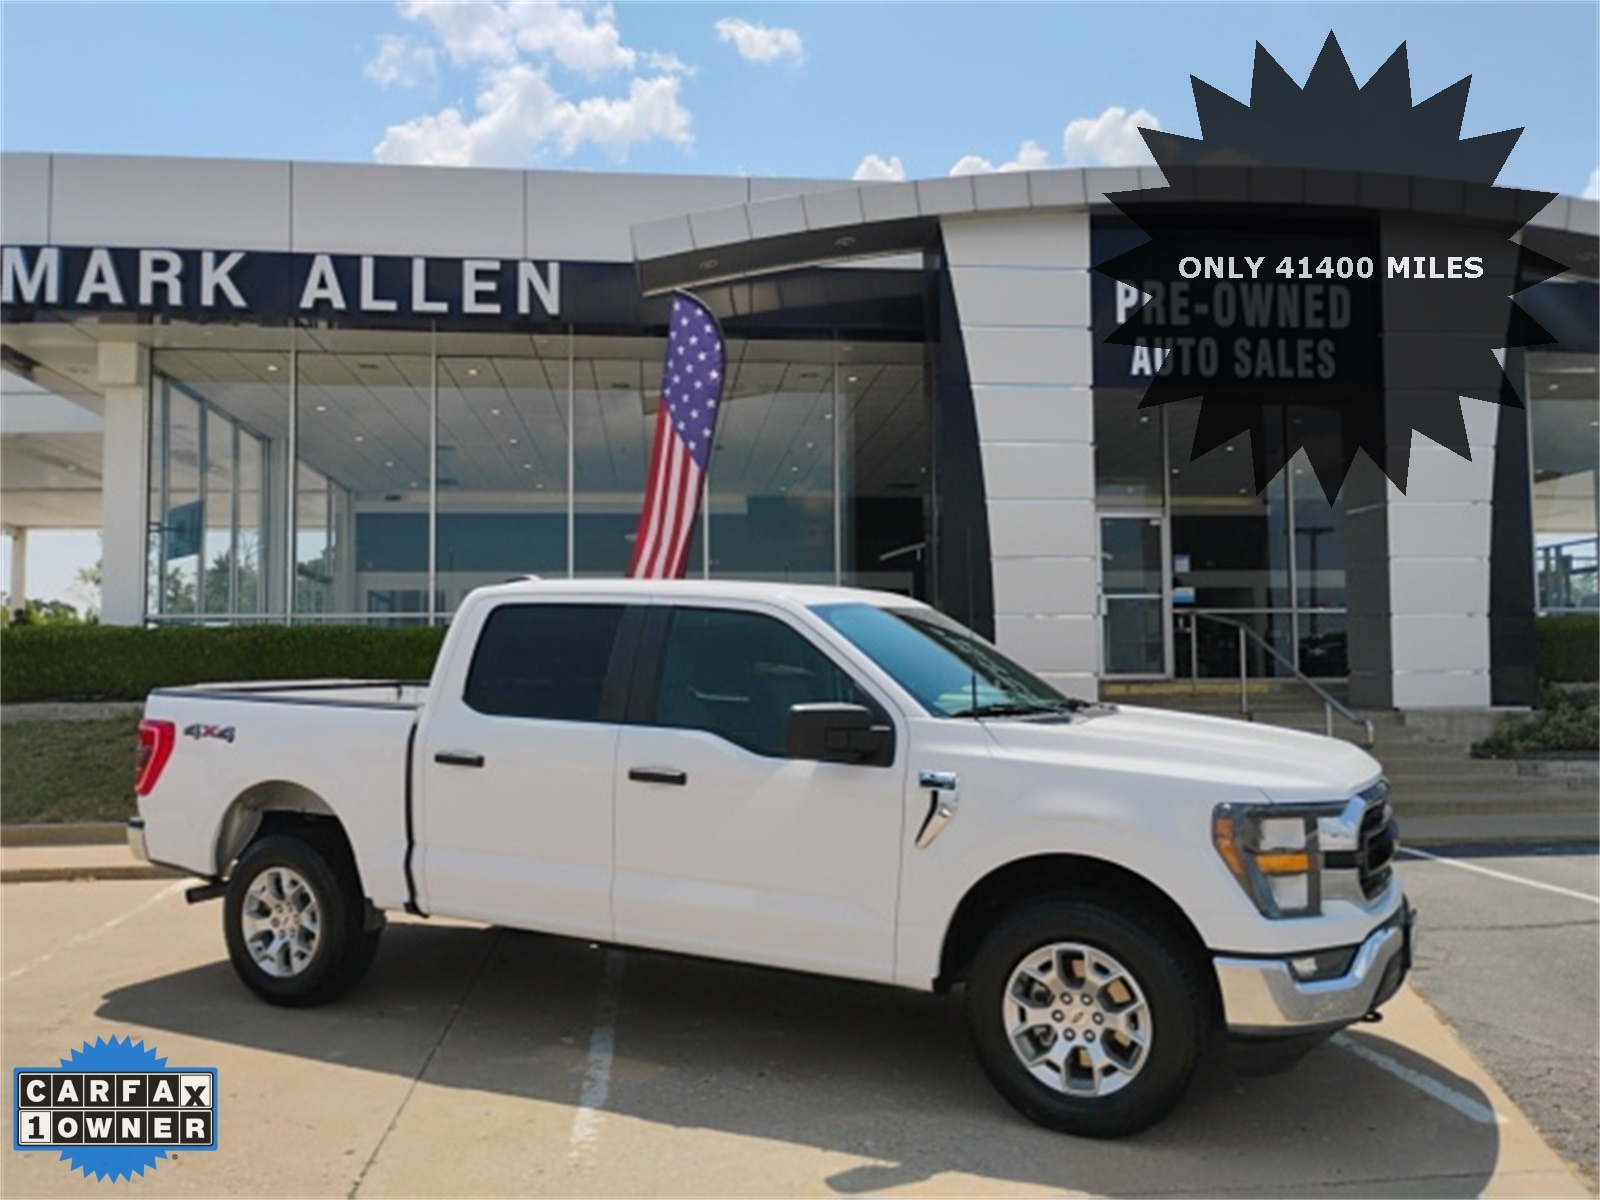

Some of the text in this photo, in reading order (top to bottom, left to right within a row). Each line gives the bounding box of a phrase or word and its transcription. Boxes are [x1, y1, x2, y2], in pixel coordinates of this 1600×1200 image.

[2, 246, 563, 316] MARK ALLEN
[1114, 279, 1353, 330] PRE-OWNED
[1130, 337, 1337, 380] AUTO SALES
